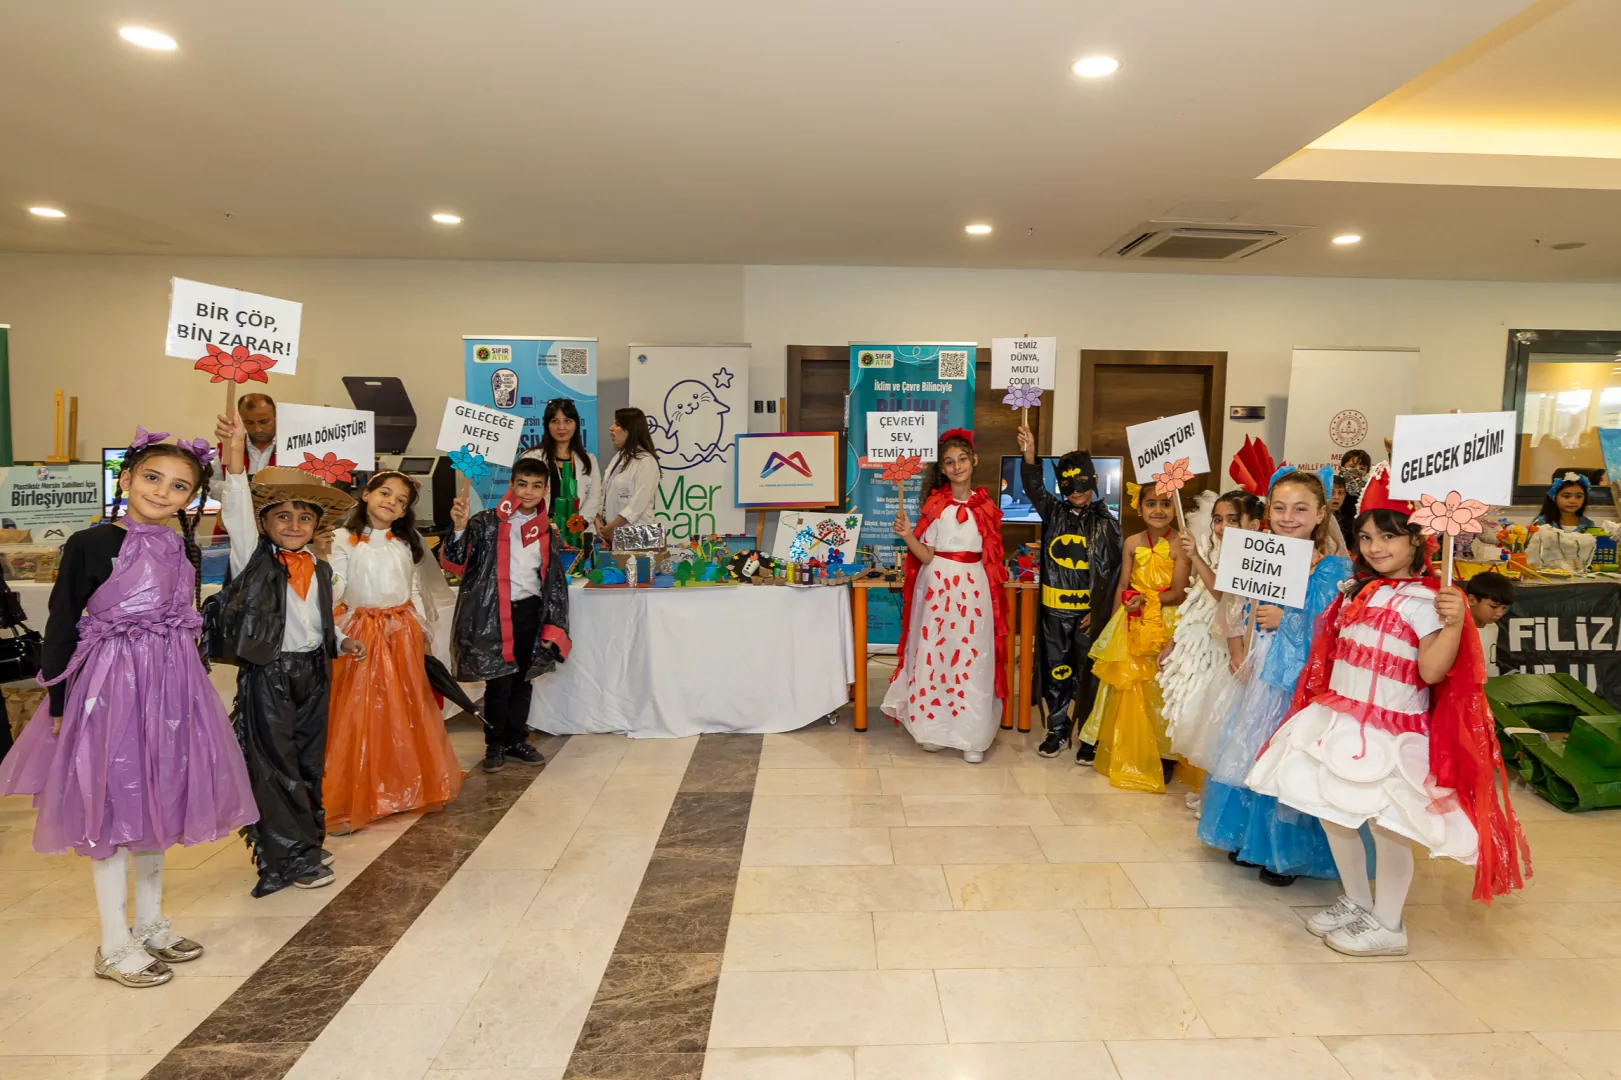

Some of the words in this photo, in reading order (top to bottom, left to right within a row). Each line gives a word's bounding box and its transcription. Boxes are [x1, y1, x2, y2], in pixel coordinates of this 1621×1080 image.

[196, 301, 229, 321] BİR
[236, 309, 278, 333] ÇÖP,
[177, 323, 212, 343] BİN
[218, 331, 291, 356] ZARAR!
[1013, 340, 1038, 349] TEMİZ
[491, 353, 509, 361] ATIK
[1010, 352, 1040, 362] DÜNYA,
[1011, 365, 1039, 374] MUTLU
[874, 379, 892, 391] İklim
[892, 383, 901, 391] ve
[902, 381, 920, 393] Çevre
[921, 381, 953, 393] Bilinciyle
[455, 405, 515, 430] GELECEĞE
[522, 415, 541, 426] ersin
[879, 414, 925, 428] ÇEVREYİ
[286, 432, 312, 451] ATMA
[315, 420, 367, 444] DÖNÜŞTÜR!
[462, 424, 500, 443] NEFES
[890, 432, 914, 444] SEV,
[466, 442, 481, 456] OL
[871, 446, 905, 458] TEMİZ
[908, 447, 934, 458] TUT!
[1137, 422, 1196, 469] DÖNÜŞTÜR!
[1401, 444, 1461, 484] GELECEK
[1463, 428, 1505, 465] BİZİM!
[11, 488, 98, 509] Birleşiyoruz!
[652, 475, 722, 512] Mer
[1244, 537, 1286, 556] DOĞA
[1241, 557, 1282, 577] BİZİM
[1231, 577, 1287, 600] EVİMİZ!
